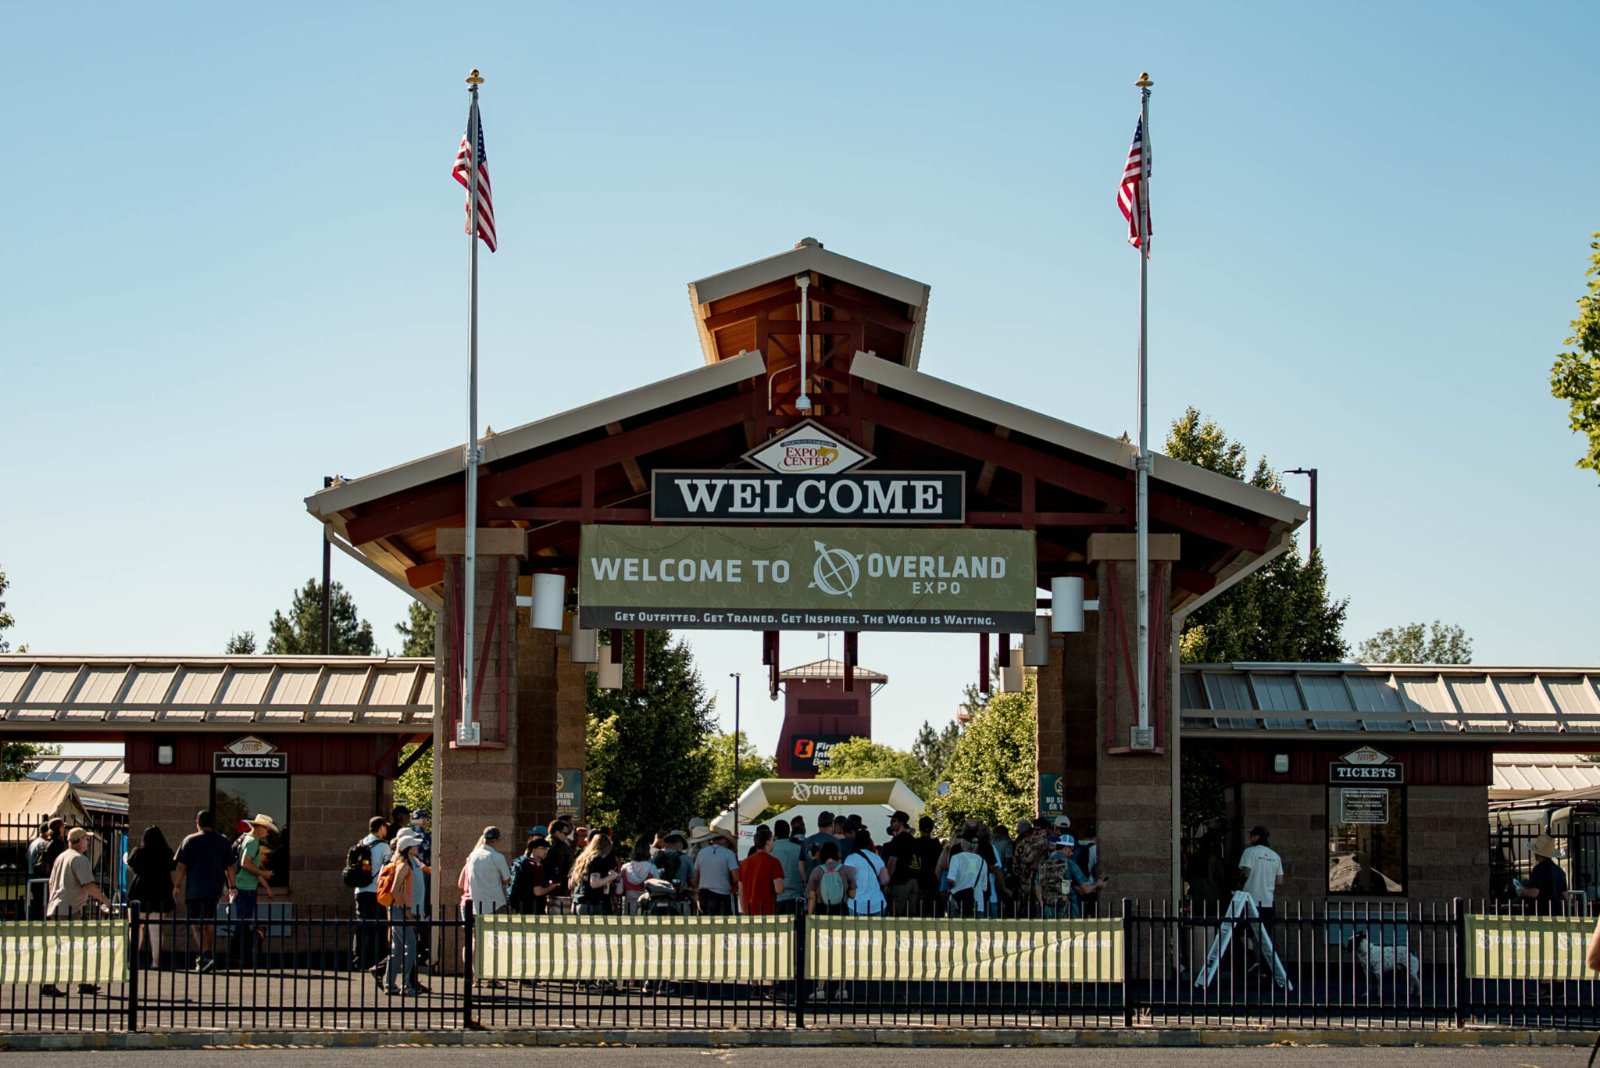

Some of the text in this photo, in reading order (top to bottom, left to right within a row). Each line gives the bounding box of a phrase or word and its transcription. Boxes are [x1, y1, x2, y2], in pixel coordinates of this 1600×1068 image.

[785, 447, 818, 457] EXPO
[783, 456, 830, 467] CENTER
[674, 478, 943, 514] WELCOME
[591, 557, 790, 583] WELCOME TO
[867, 553, 1006, 579] OVERLAND
[912, 582, 961, 594] EXPO
[221, 757, 280, 768] TICKETS
[1337, 767, 1396, 778] TICKETS
[812, 785, 864, 795] OVERLAND
